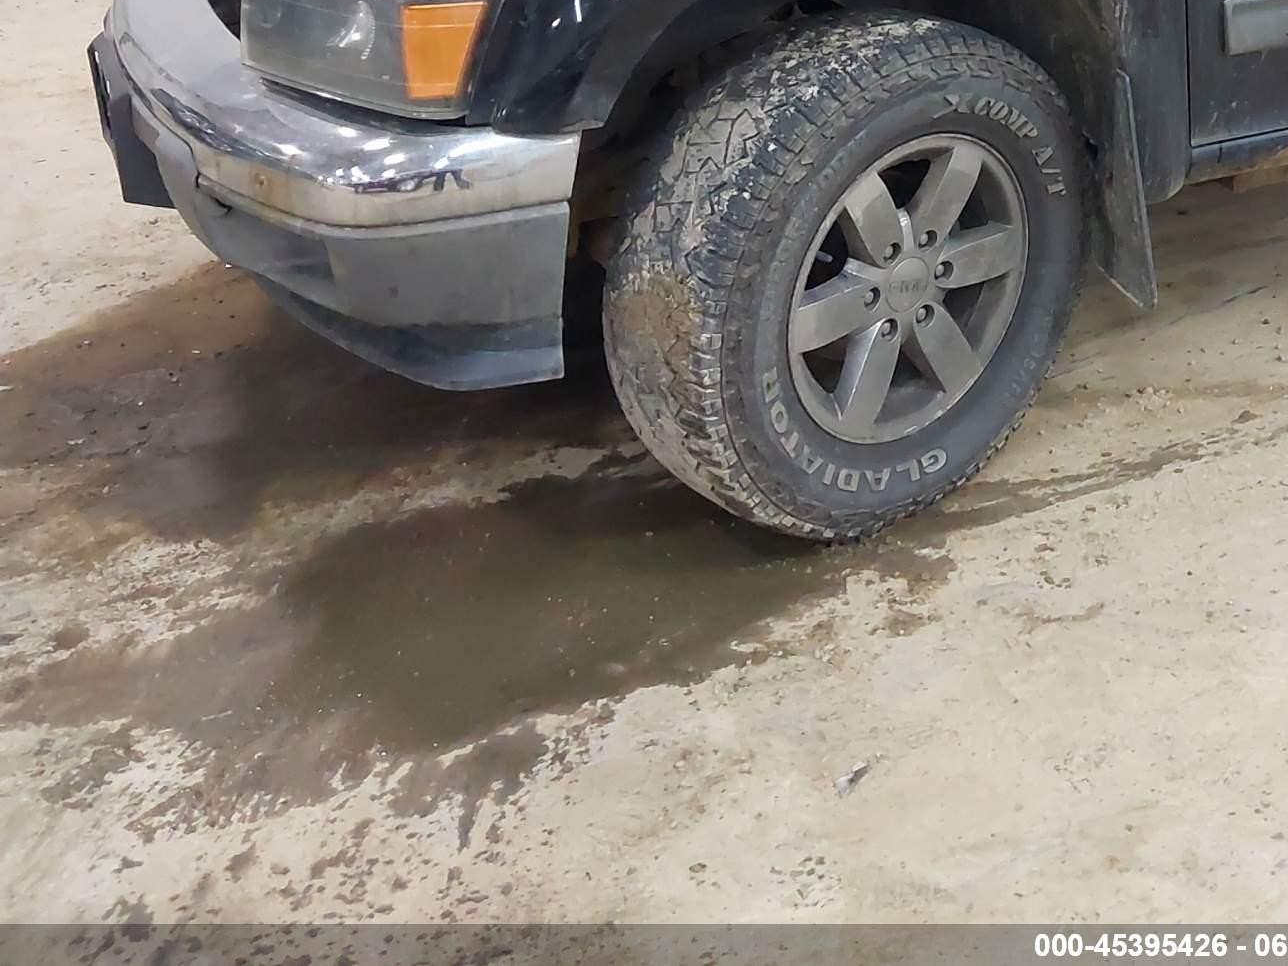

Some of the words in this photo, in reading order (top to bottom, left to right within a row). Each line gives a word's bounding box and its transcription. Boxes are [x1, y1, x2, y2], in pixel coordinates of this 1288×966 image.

[974, 96, 1039, 138] COMP
[1031, 146, 1067, 196] A/T
[762, 366, 948, 492] GLADIATOR
